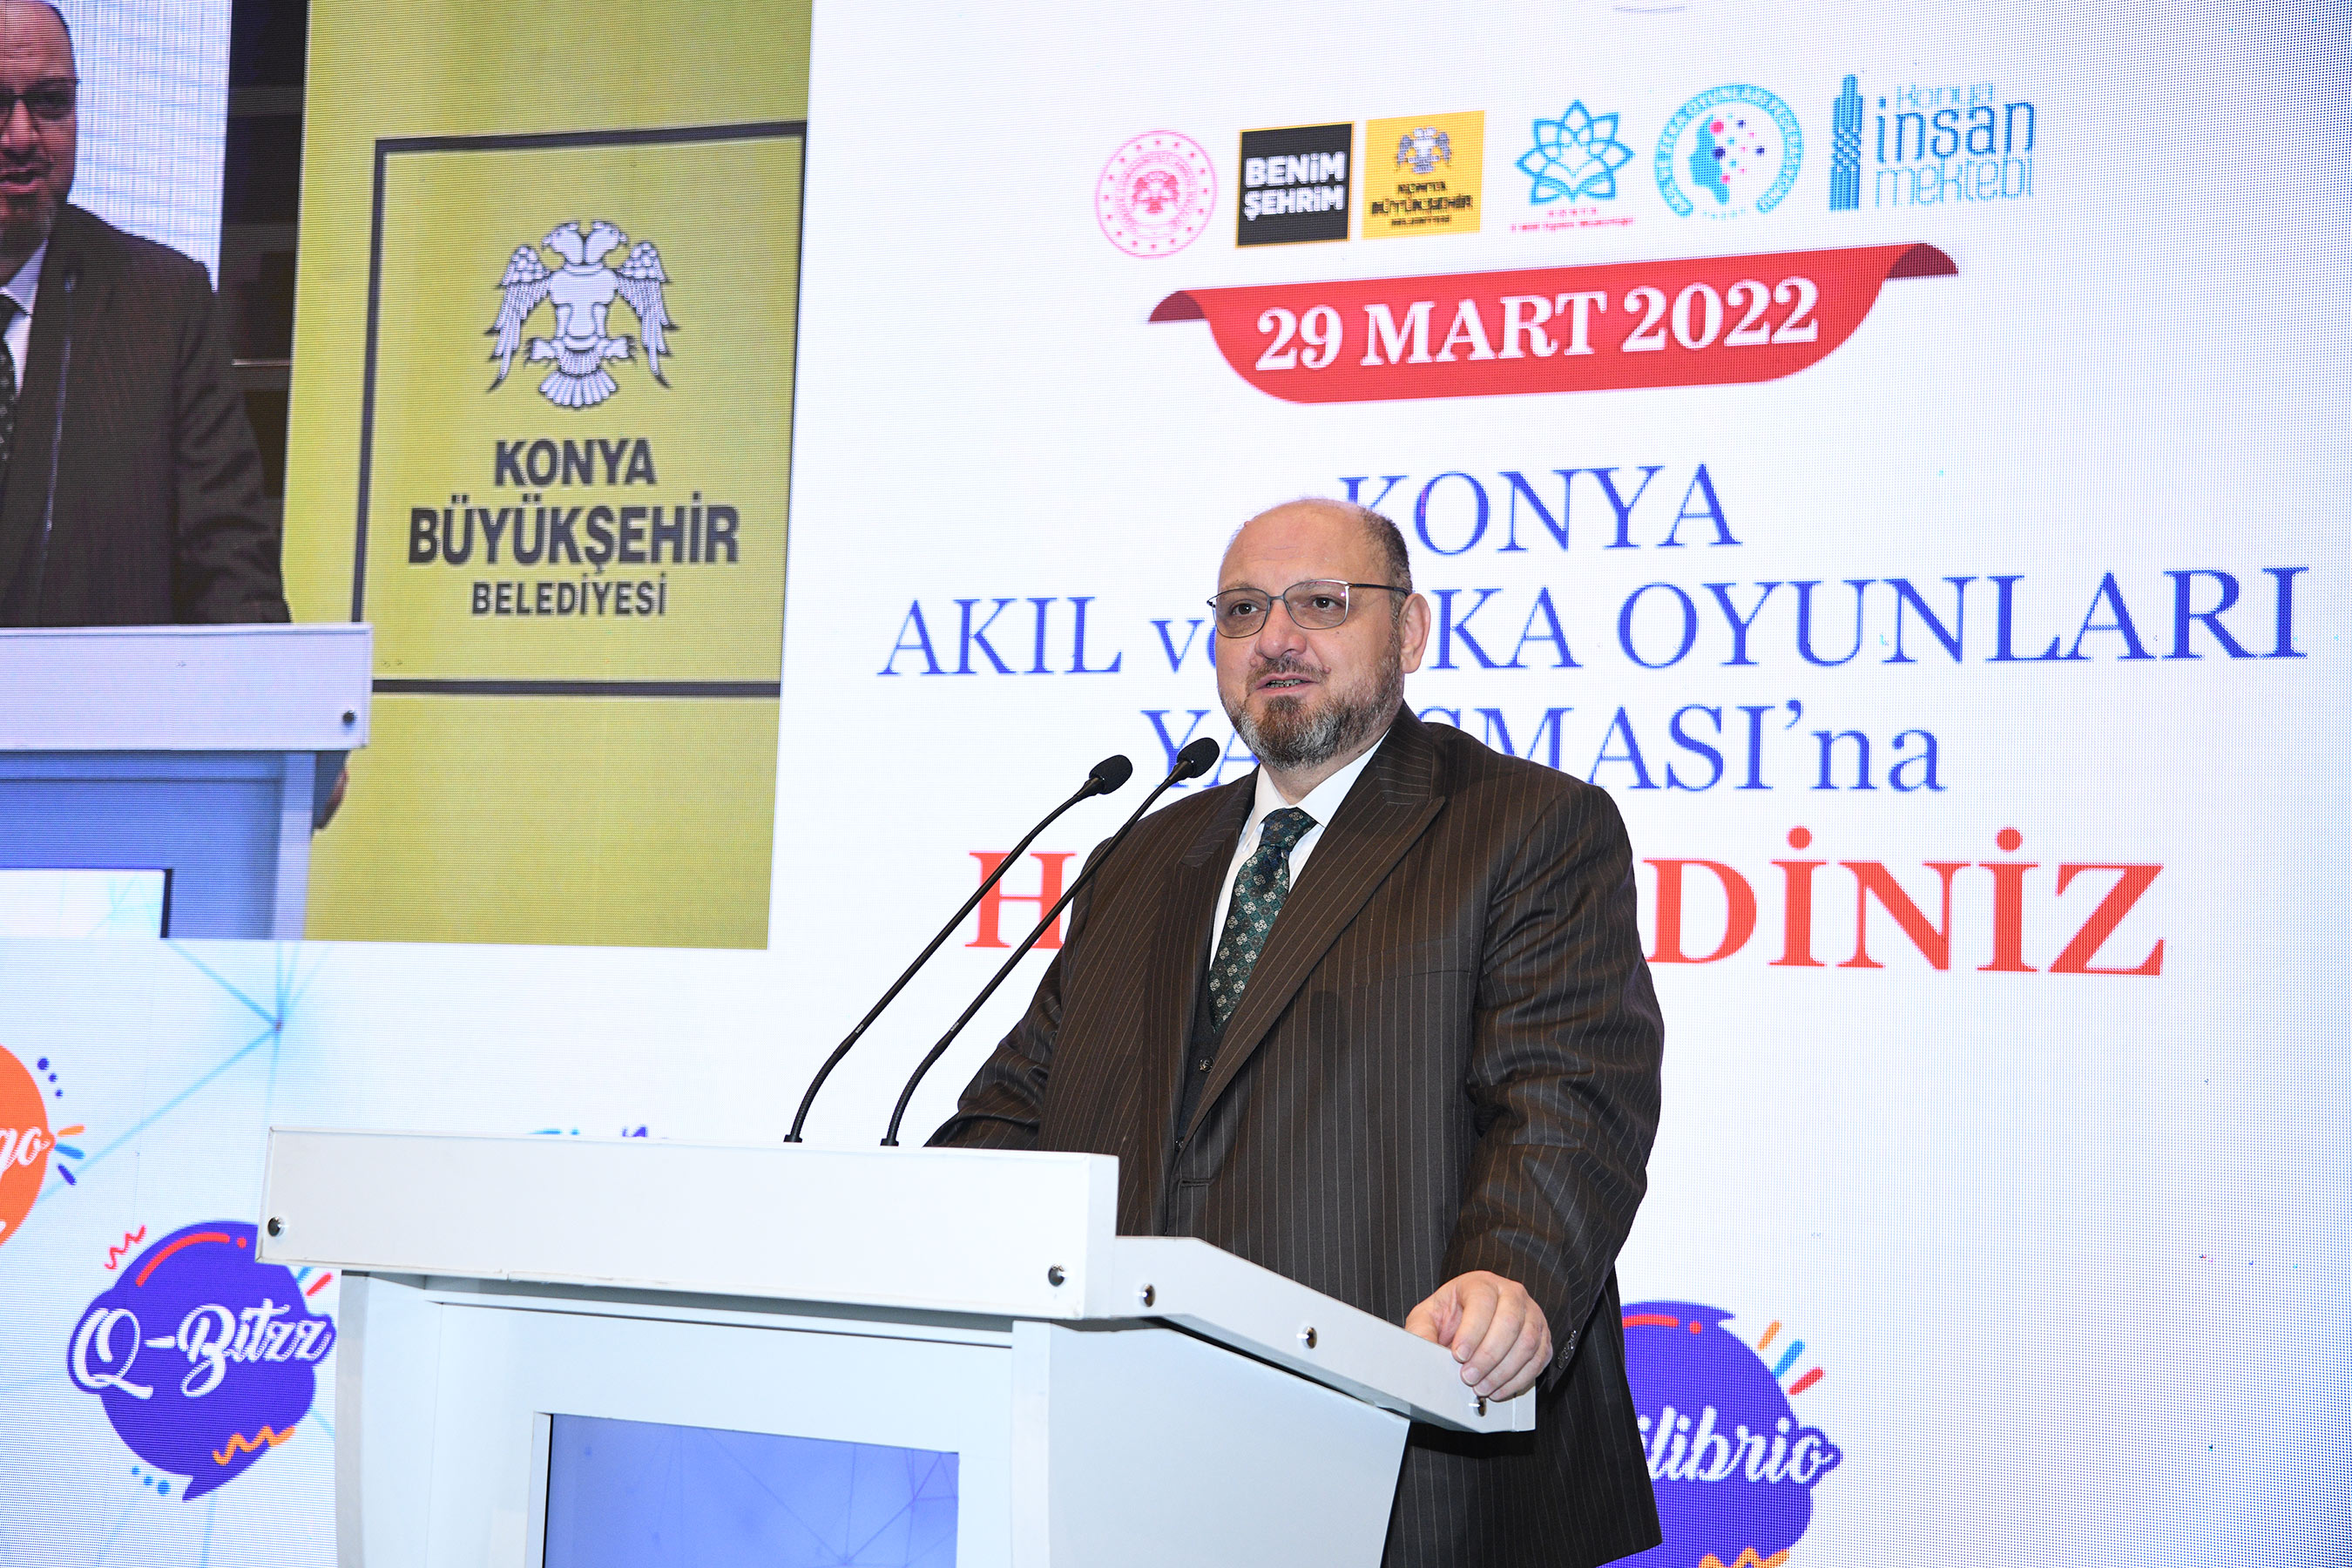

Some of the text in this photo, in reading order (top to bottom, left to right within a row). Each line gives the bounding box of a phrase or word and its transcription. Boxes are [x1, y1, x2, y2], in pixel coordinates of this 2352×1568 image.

[1876, 97, 2035, 165] insan
[1255, 276, 1819, 371] 29 MART 2022
[495, 438, 657, 488] KONYA
[408, 492, 740, 573] BÜYÜKŞEHİR
[471, 573, 666, 616] BELEDİYESİ
[877, 566, 2309, 676] AKIL v KA OYUNLARI
[1642, 825, 2165, 977] DİNİZ
[72, 1299, 332, 1399] Q-Bitzz
